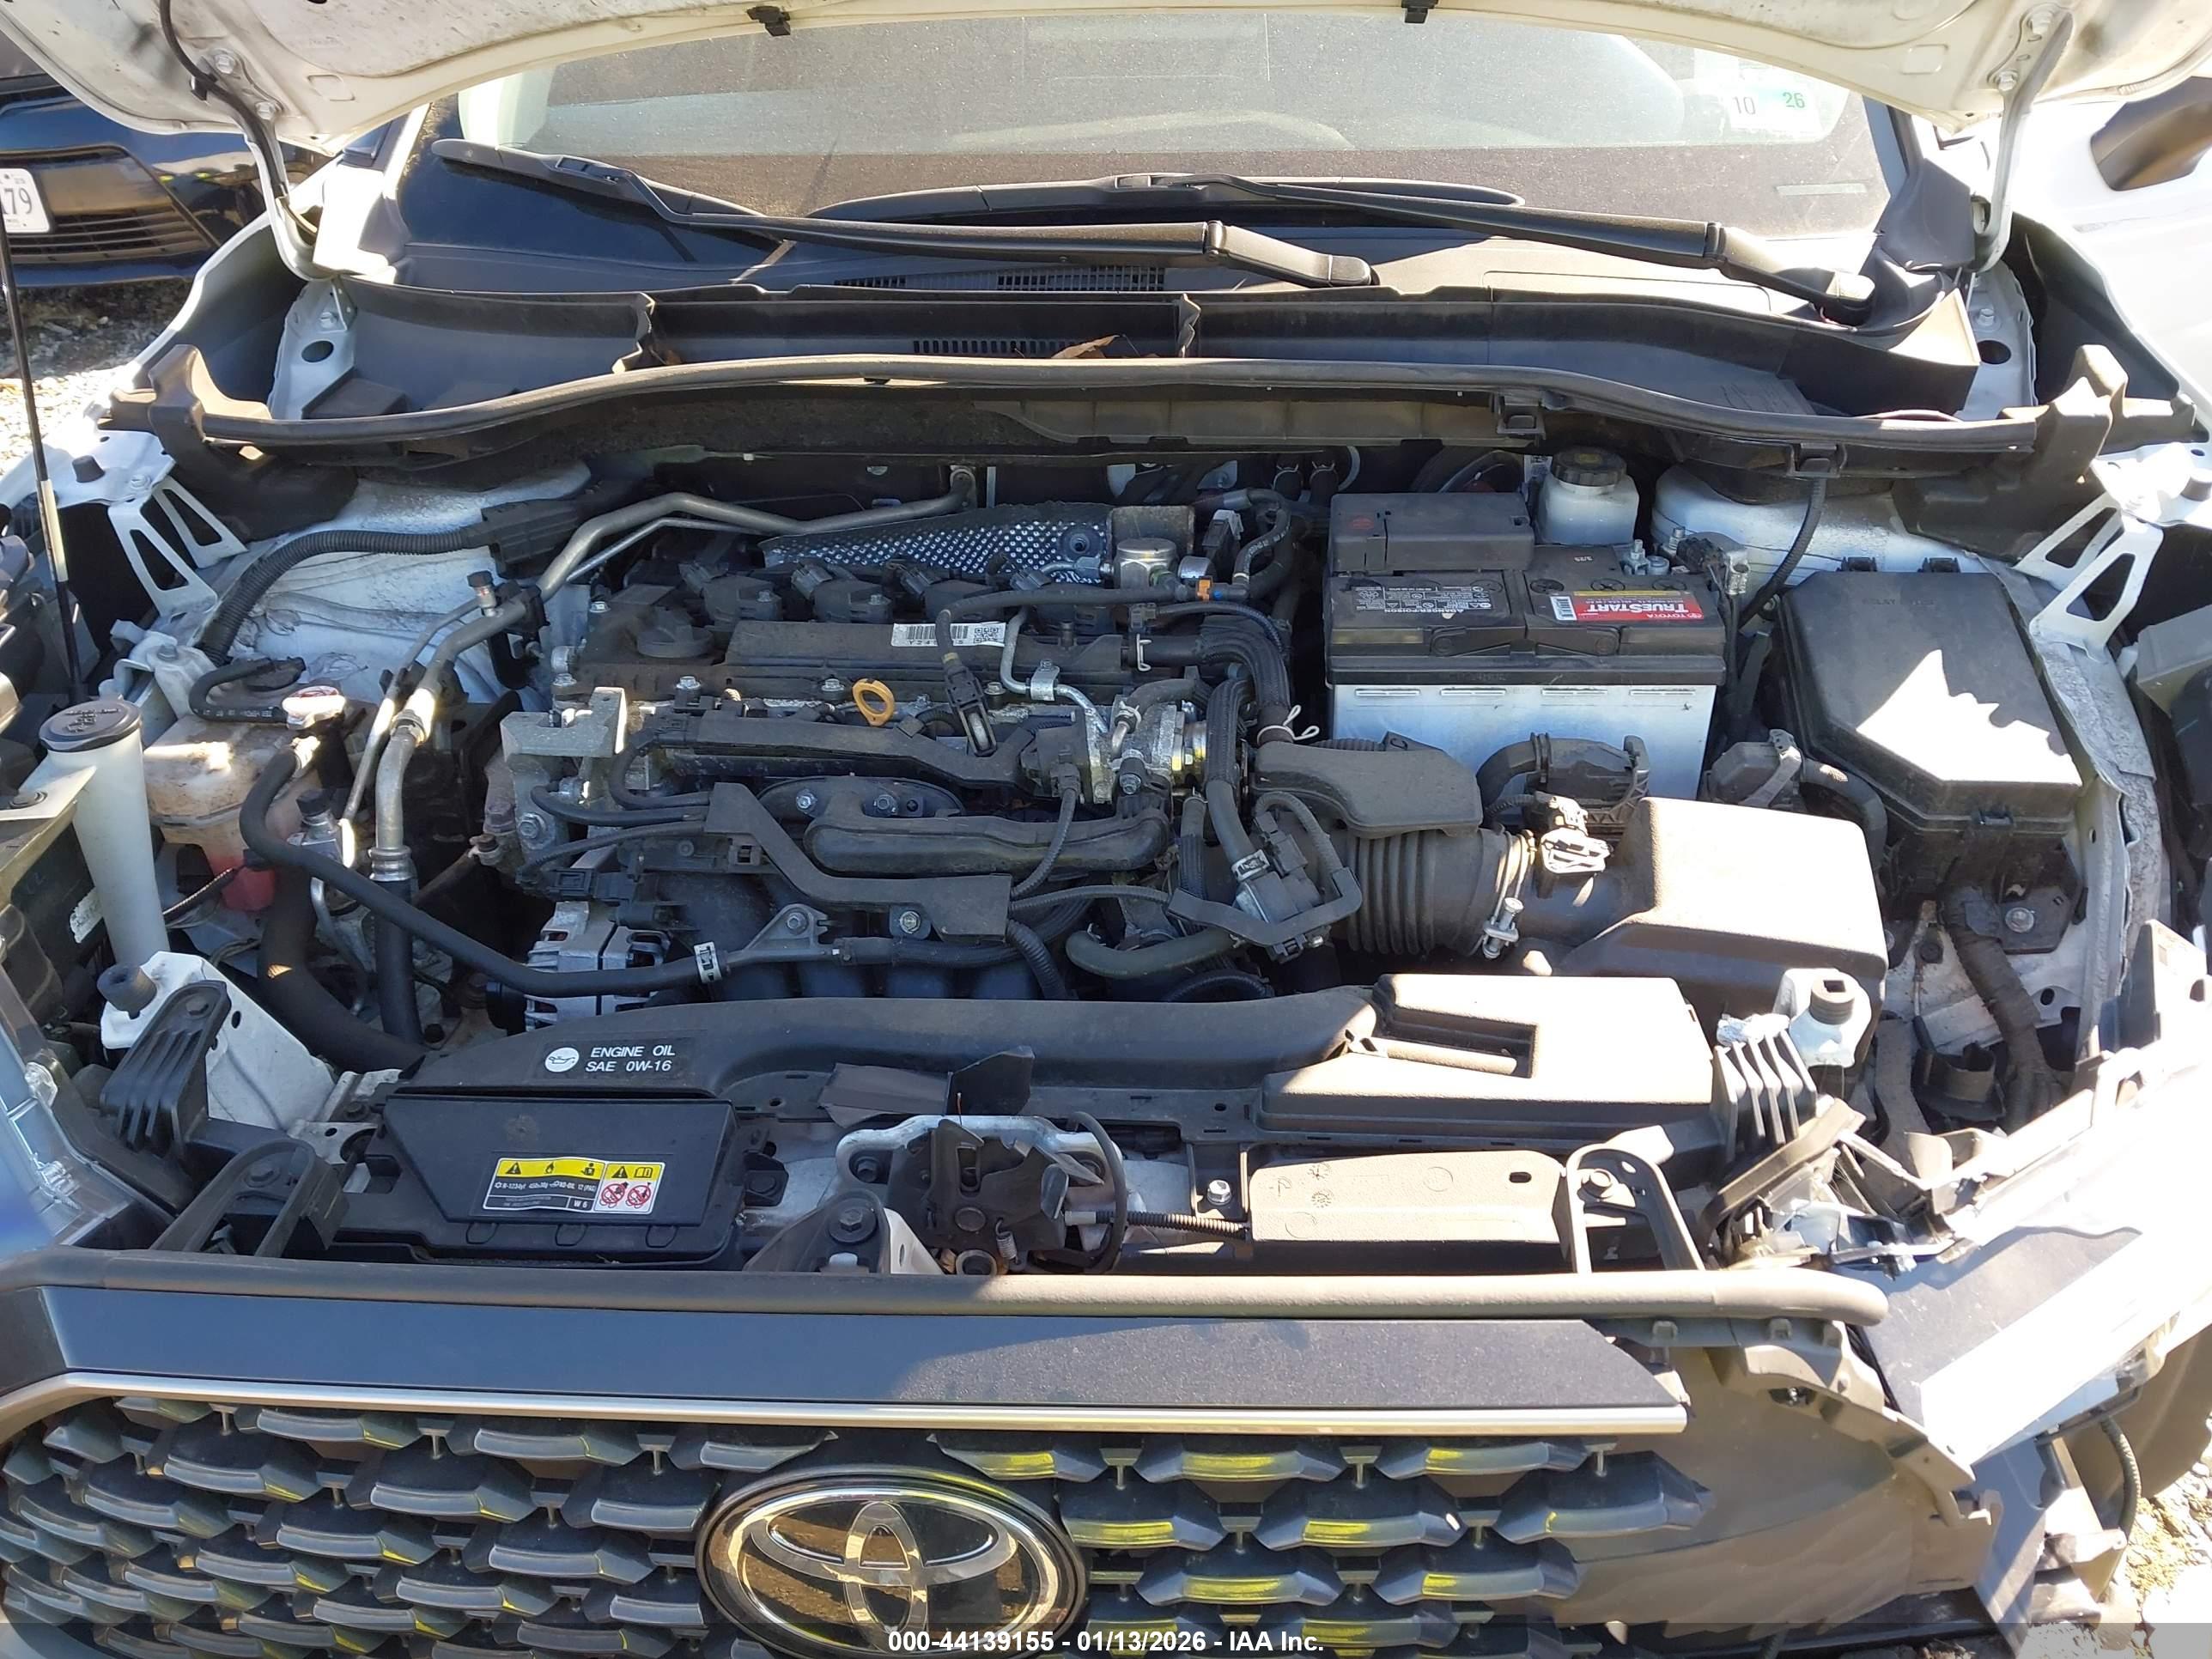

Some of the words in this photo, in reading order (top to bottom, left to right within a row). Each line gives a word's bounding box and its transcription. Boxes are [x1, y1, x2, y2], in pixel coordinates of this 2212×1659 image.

[1733, 96, 1756, 115] 10
[1782, 91, 1806, 108] 26
[590, 1046, 645, 1058] ENGINE
[652, 1044, 676, 1056] OIL
[585, 1060, 617, 1072] SAE
[625, 1060, 672, 1072] 0W-16
